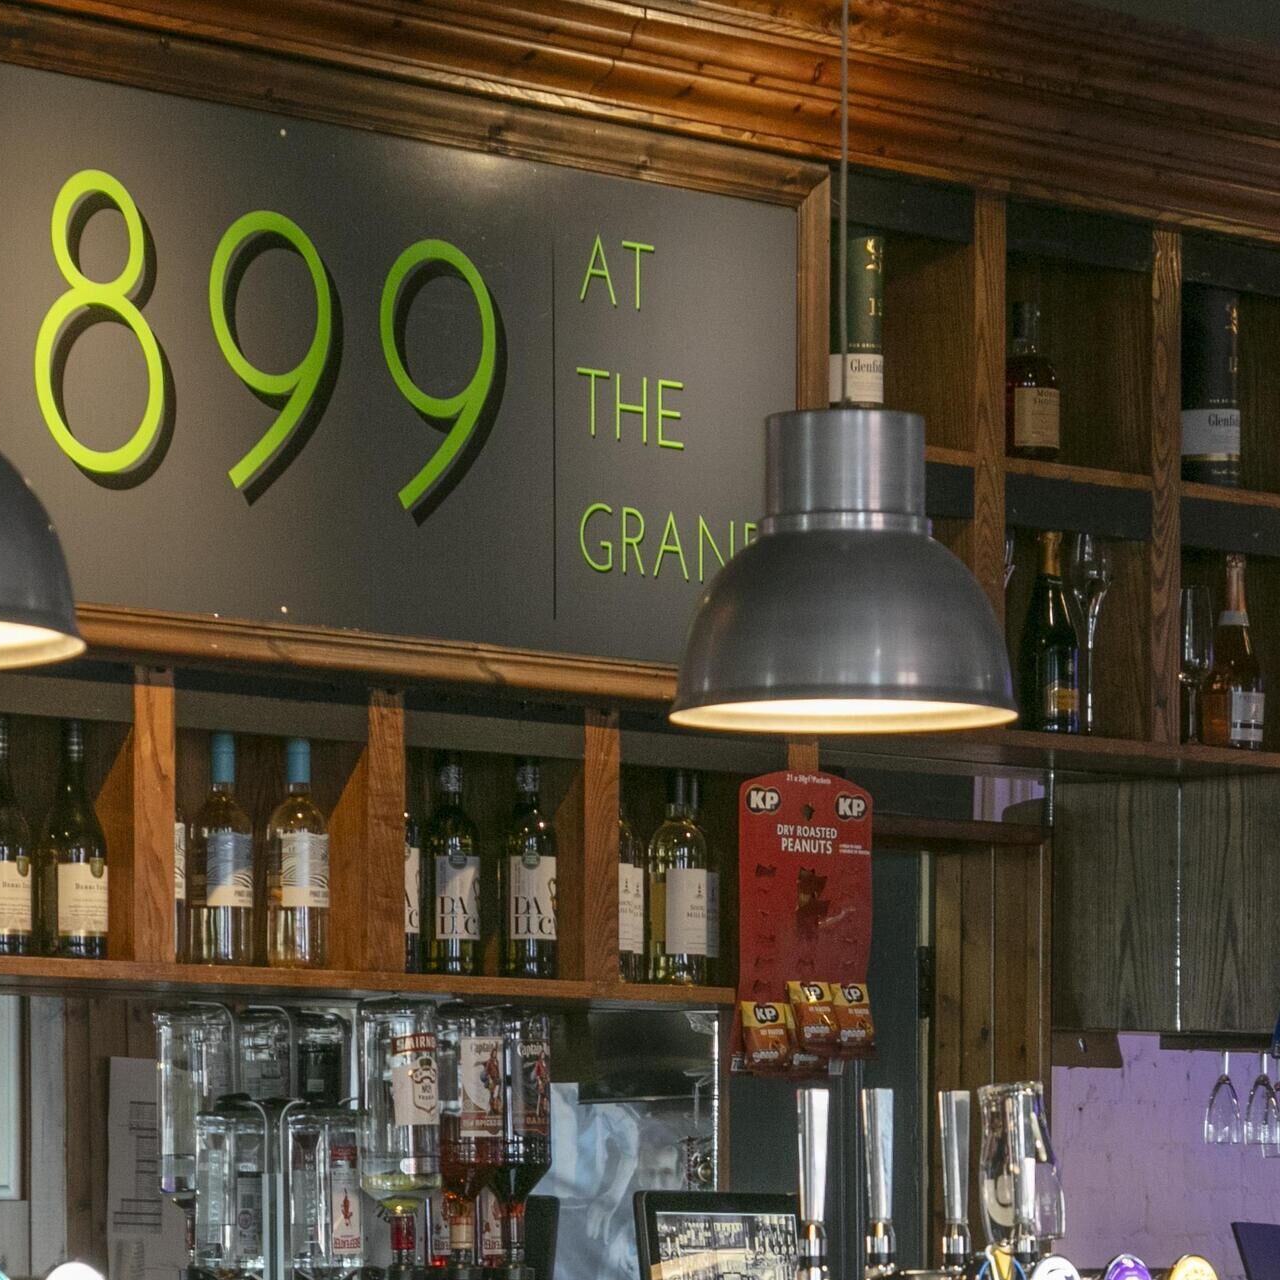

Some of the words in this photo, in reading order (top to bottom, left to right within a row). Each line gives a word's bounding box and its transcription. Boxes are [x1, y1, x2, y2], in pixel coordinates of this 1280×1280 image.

[579, 231, 656, 314] AT
[577, 365, 685, 451] THE
[750, 790, 780, 810] KP
[838, 797, 866, 817] KP
[777, 824, 795, 836] DRY
[797, 826, 838, 839] ROASTED
[781, 838, 833, 855] PEANUTS
